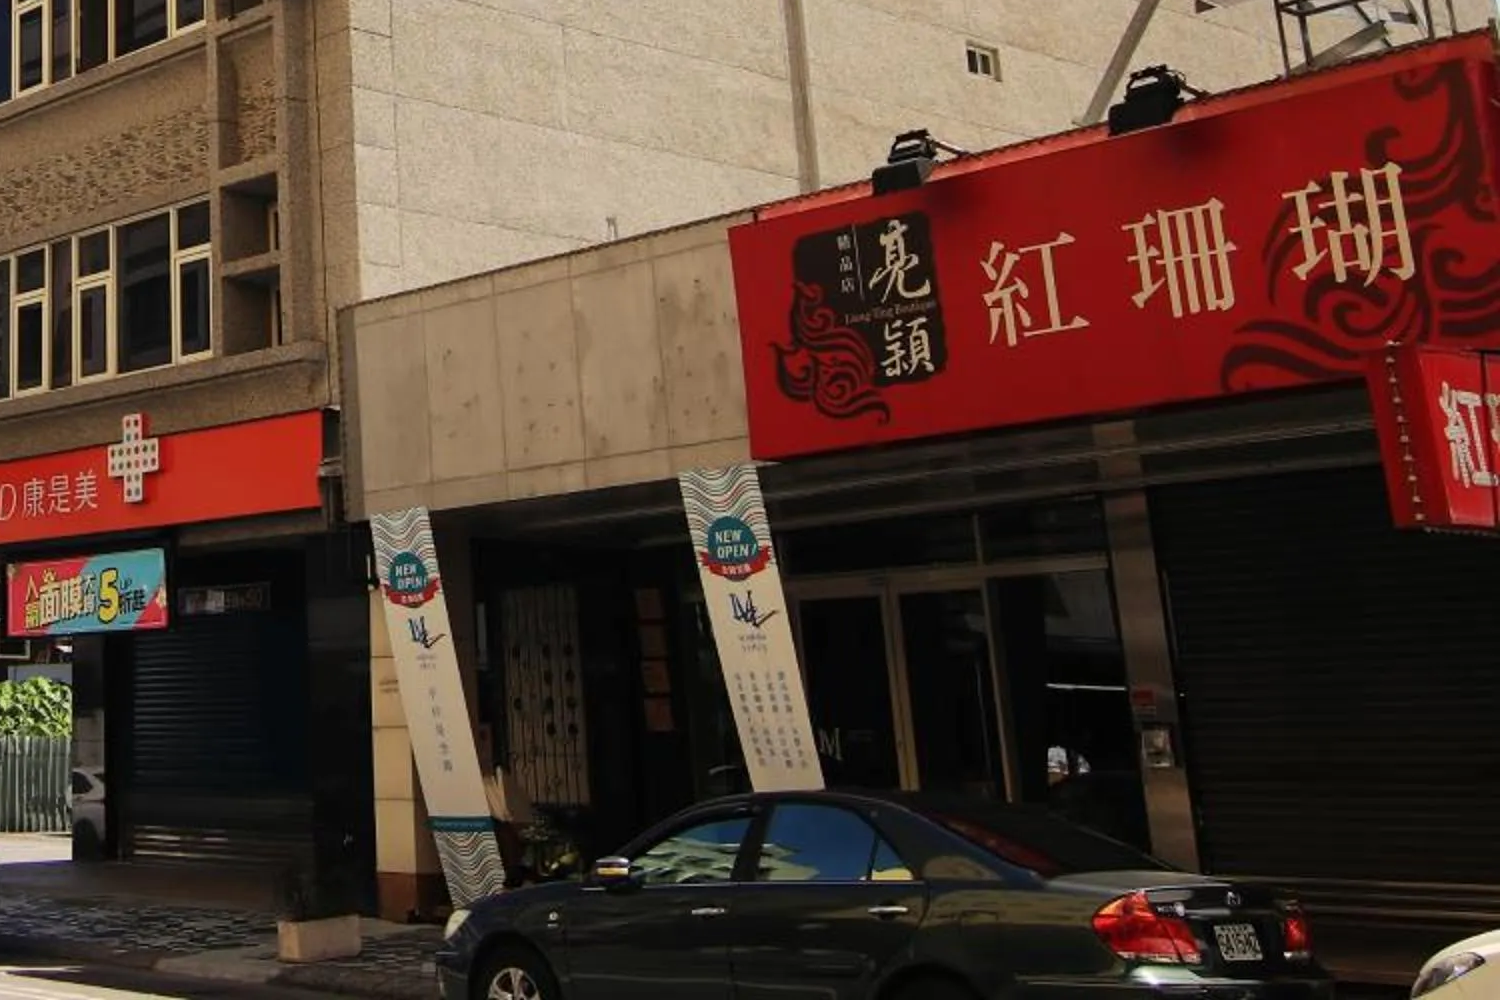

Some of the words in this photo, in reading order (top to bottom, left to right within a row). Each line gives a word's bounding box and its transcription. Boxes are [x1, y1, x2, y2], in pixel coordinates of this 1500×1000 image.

[980, 162, 1416, 347] 紅珊瑚
[1439, 381, 1500, 489] 紅
[23, 470, 98, 518] 康是美
[715, 529, 743, 545] NEW
